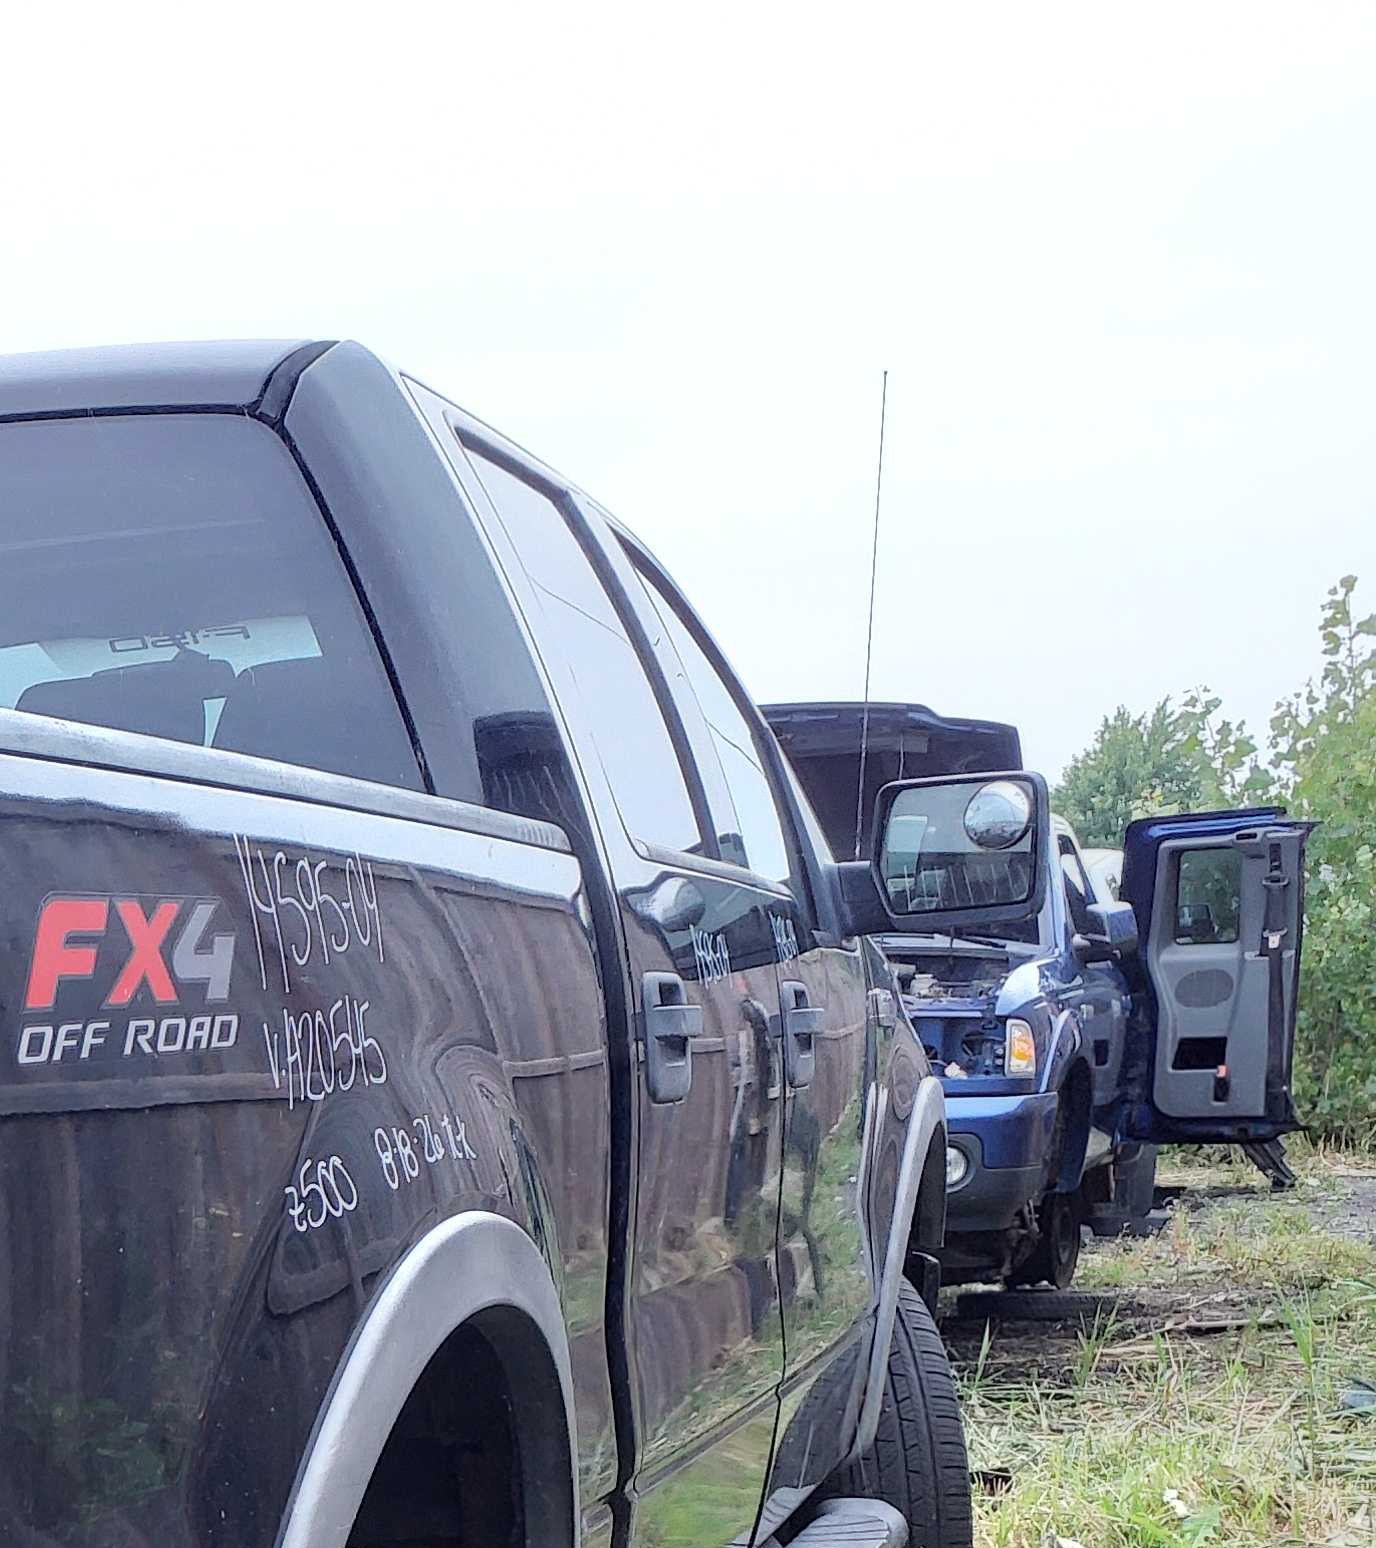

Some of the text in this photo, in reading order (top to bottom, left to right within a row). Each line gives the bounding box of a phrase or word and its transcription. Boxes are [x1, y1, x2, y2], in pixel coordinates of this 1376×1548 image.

[25, 899, 236, 1011] FX4
[17, 1014, 239, 1065] OFF ROAD
